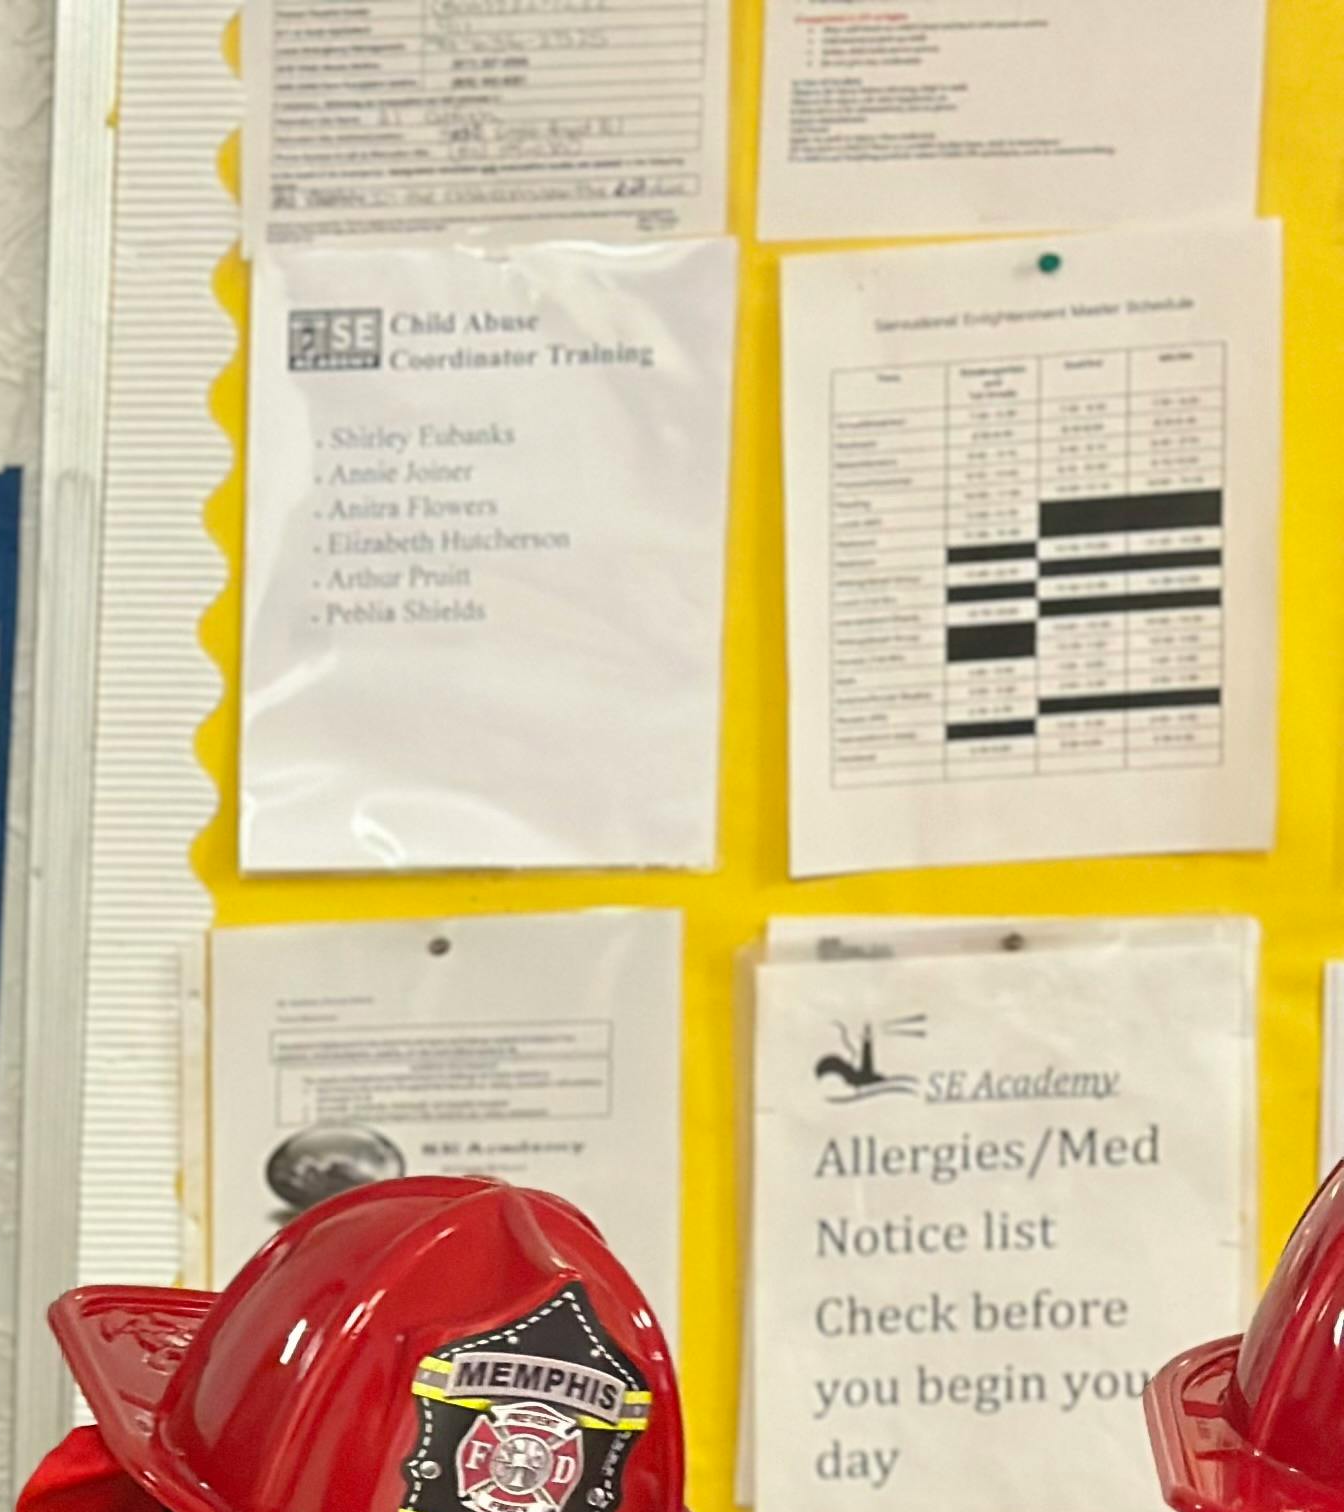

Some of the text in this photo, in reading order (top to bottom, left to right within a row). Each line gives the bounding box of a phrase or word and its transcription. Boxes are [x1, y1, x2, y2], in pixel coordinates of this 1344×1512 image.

[389, 312, 540, 336] Child Abuse
[389, 342, 655, 371] Coordinator Training
[329, 423, 516, 455] Shirley Eubanks
[328, 460, 473, 486] Annie Joiner
[407, 496, 499, 518] Flowers
[328, 528, 571, 556] Elizabeth Hutcherson
[326, 567, 401, 591] Arthur
[402, 599, 486, 623] Shields
[925, 1064, 1121, 1102] SE Academy
[814, 1125, 1161, 1185] Allergies/Med
[815, 1209, 1057, 1259] Notice list
[814, 1287, 1130, 1338] Check before
[454, 1360, 618, 1412] MEMPHIS
[812, 1376, 900, 1419] you
[916, 1364, 1047, 1418] begin
[465, 1439, 576, 1485] F D
[814, 1439, 902, 1489] day
